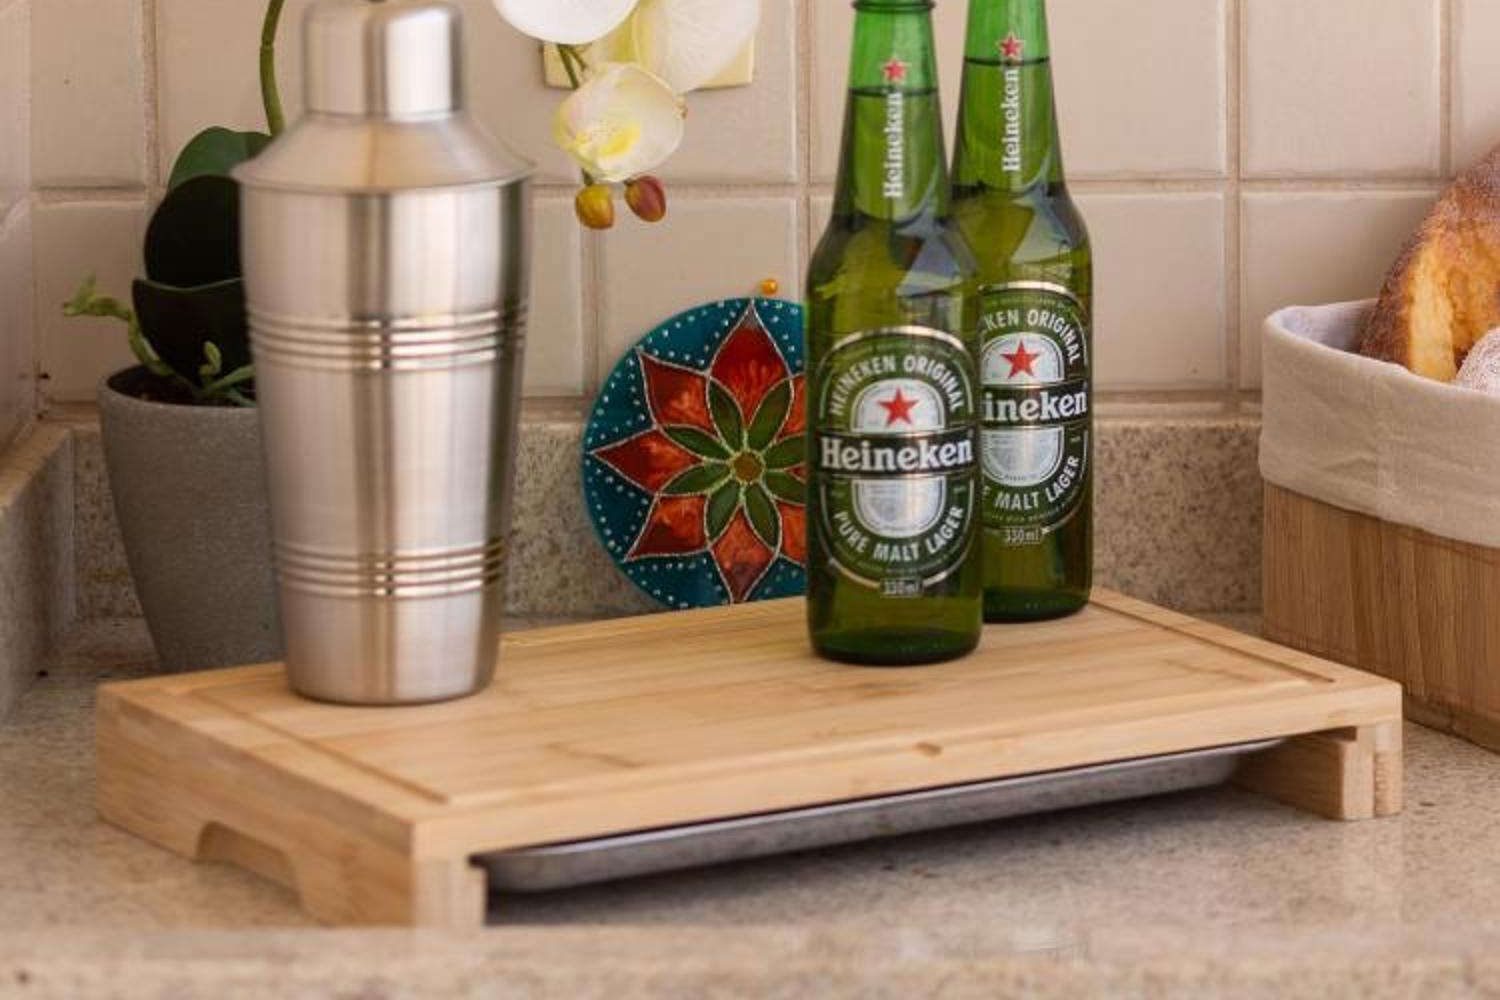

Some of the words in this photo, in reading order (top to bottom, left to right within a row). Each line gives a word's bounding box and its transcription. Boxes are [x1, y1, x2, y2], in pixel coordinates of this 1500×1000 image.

[883, 90, 903, 199] Heineken
[1001, 66, 1020, 172] Heineken
[1027, 309, 1080, 365] ORIGINAL
[830, 355, 896, 416] HEINEKEN
[903, 355, 964, 413] ORIGINAL
[985, 391, 1088, 422] ineken
[821, 437, 973, 471] Heineken
[995, 490, 1040, 511] MALT
[1045, 455, 1079, 502] LAGER
[834, 511, 870, 553] PURE
[874, 543, 919, 562] MALT
[925, 506, 964, 554] LAGER
